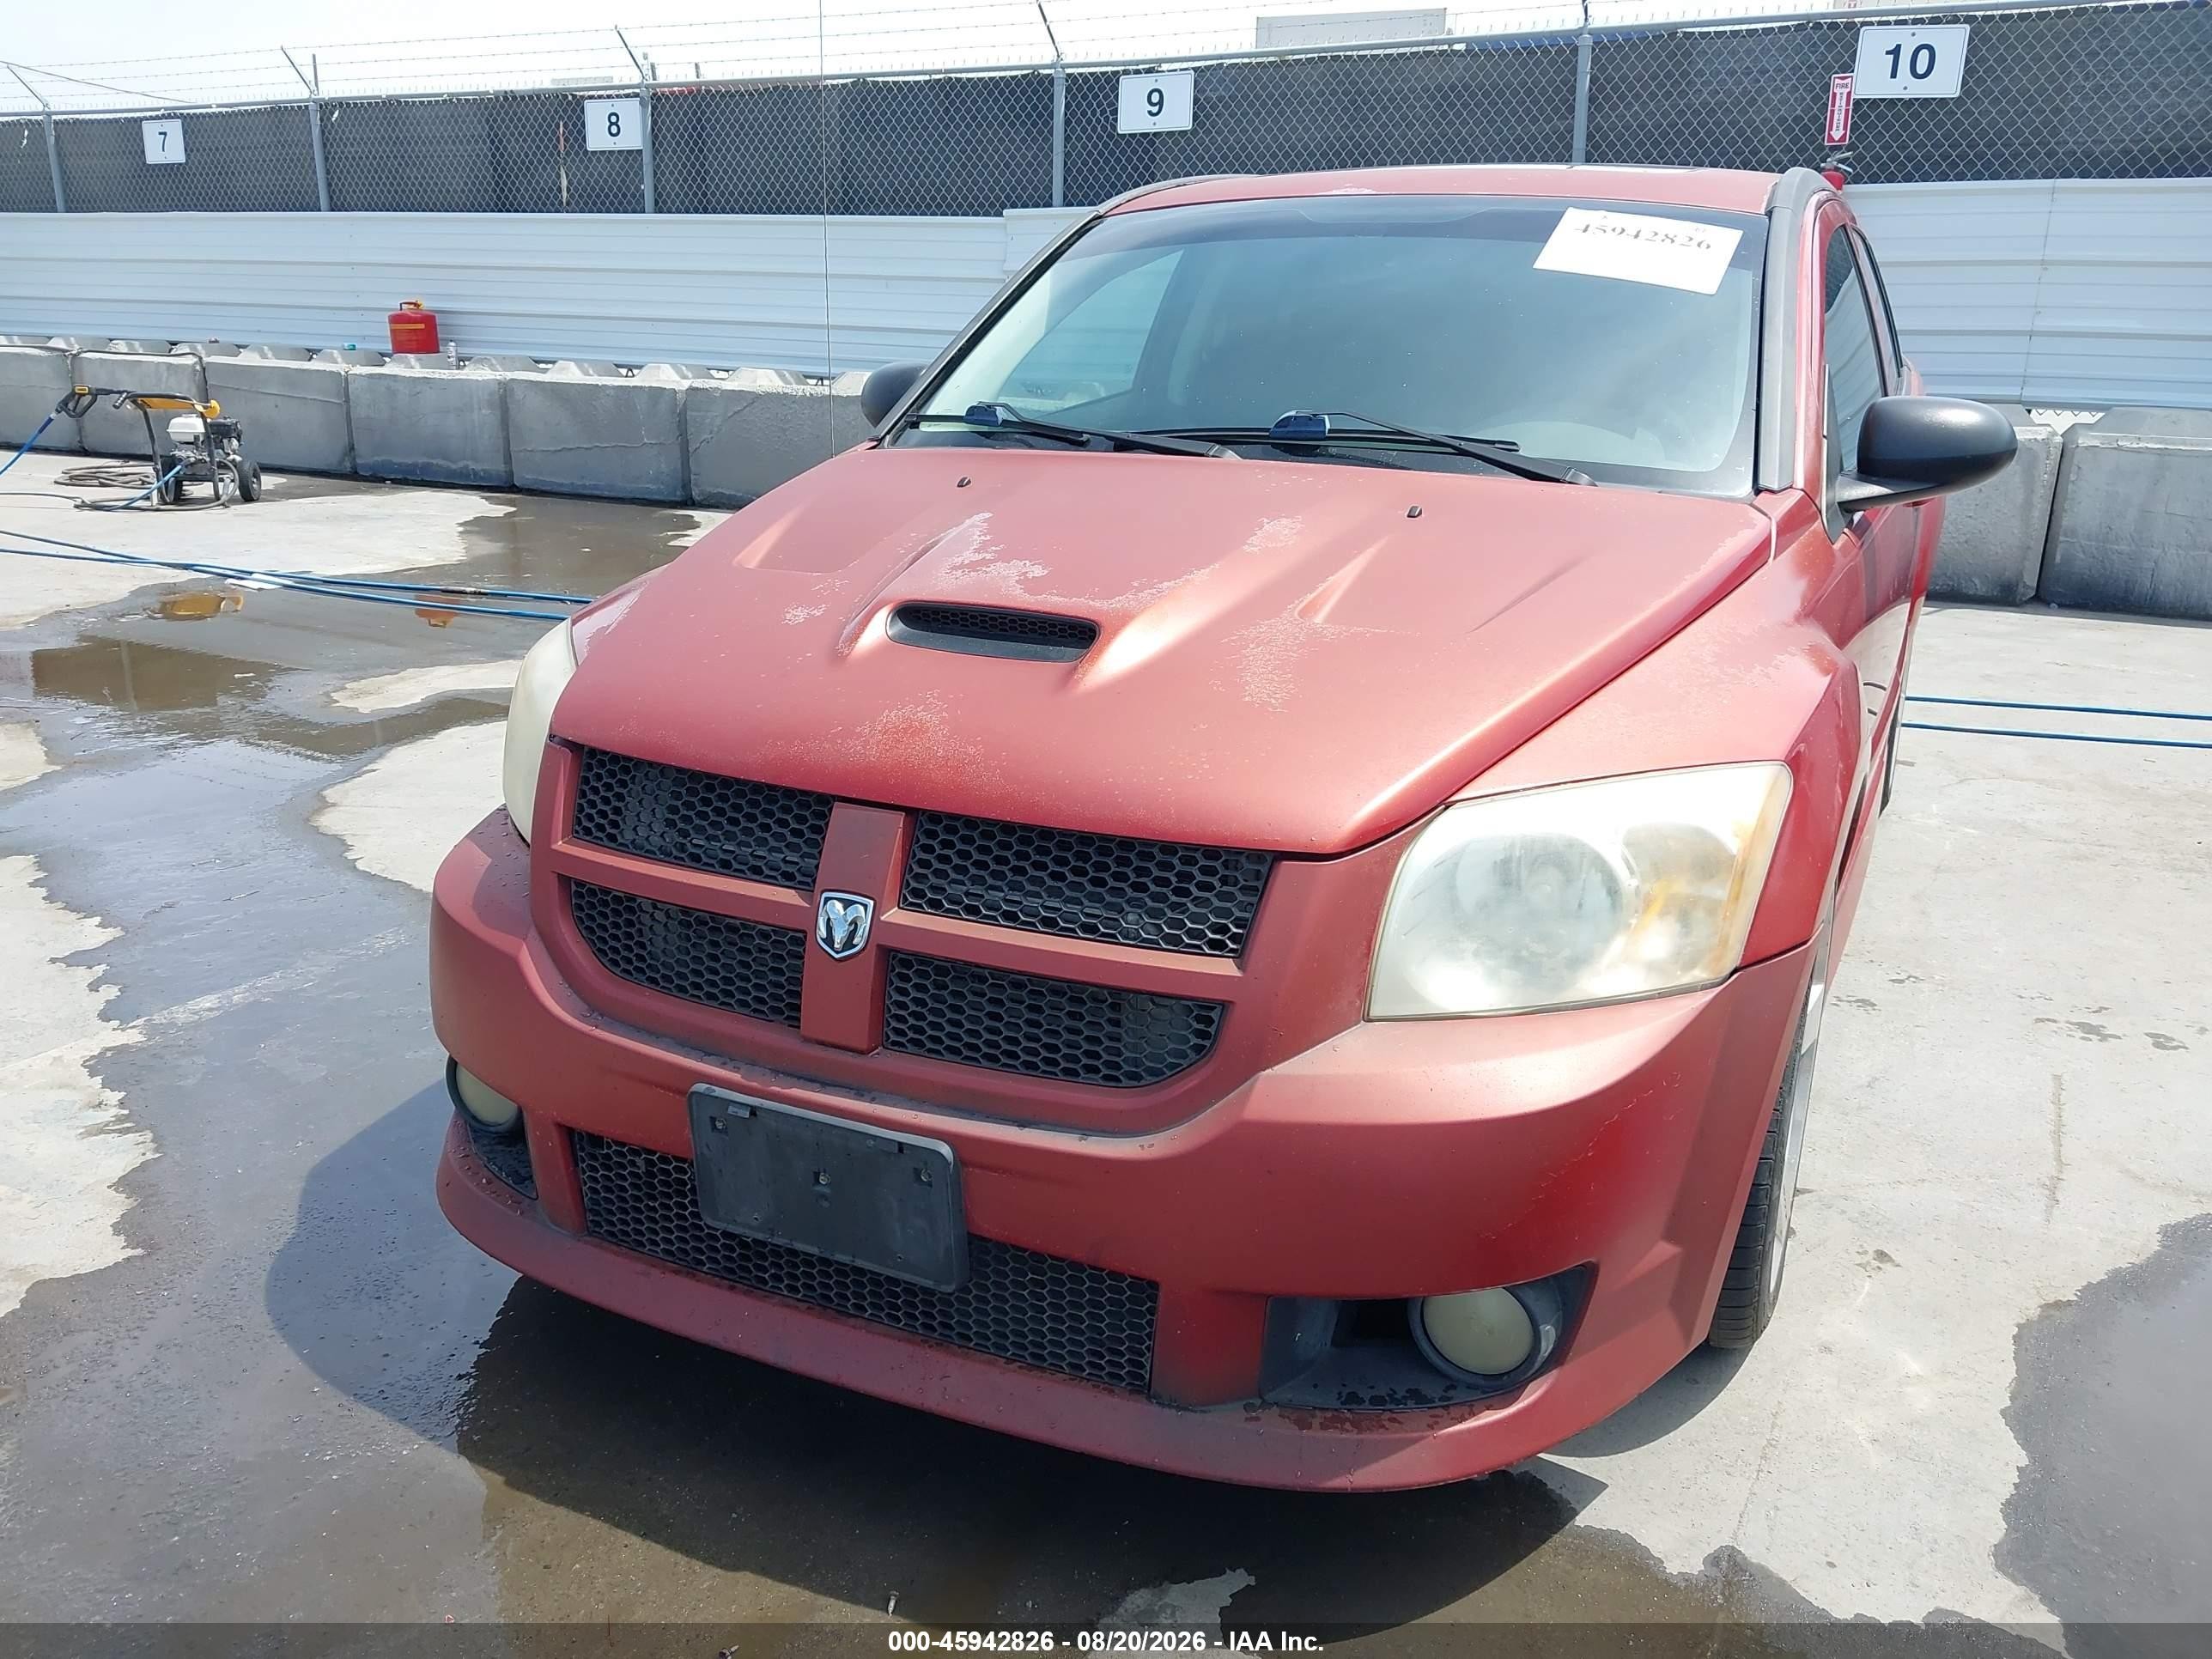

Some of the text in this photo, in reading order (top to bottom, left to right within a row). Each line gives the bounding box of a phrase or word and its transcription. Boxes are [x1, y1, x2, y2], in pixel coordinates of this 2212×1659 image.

[1885, 43, 1936, 80] 10
[1835, 82, 1850, 90] FIRE
[1146, 88, 1164, 118] 9
[607, 112, 621, 137] 8
[158, 131, 167, 153] 7
[1573, 222, 1712, 251] 45942826
